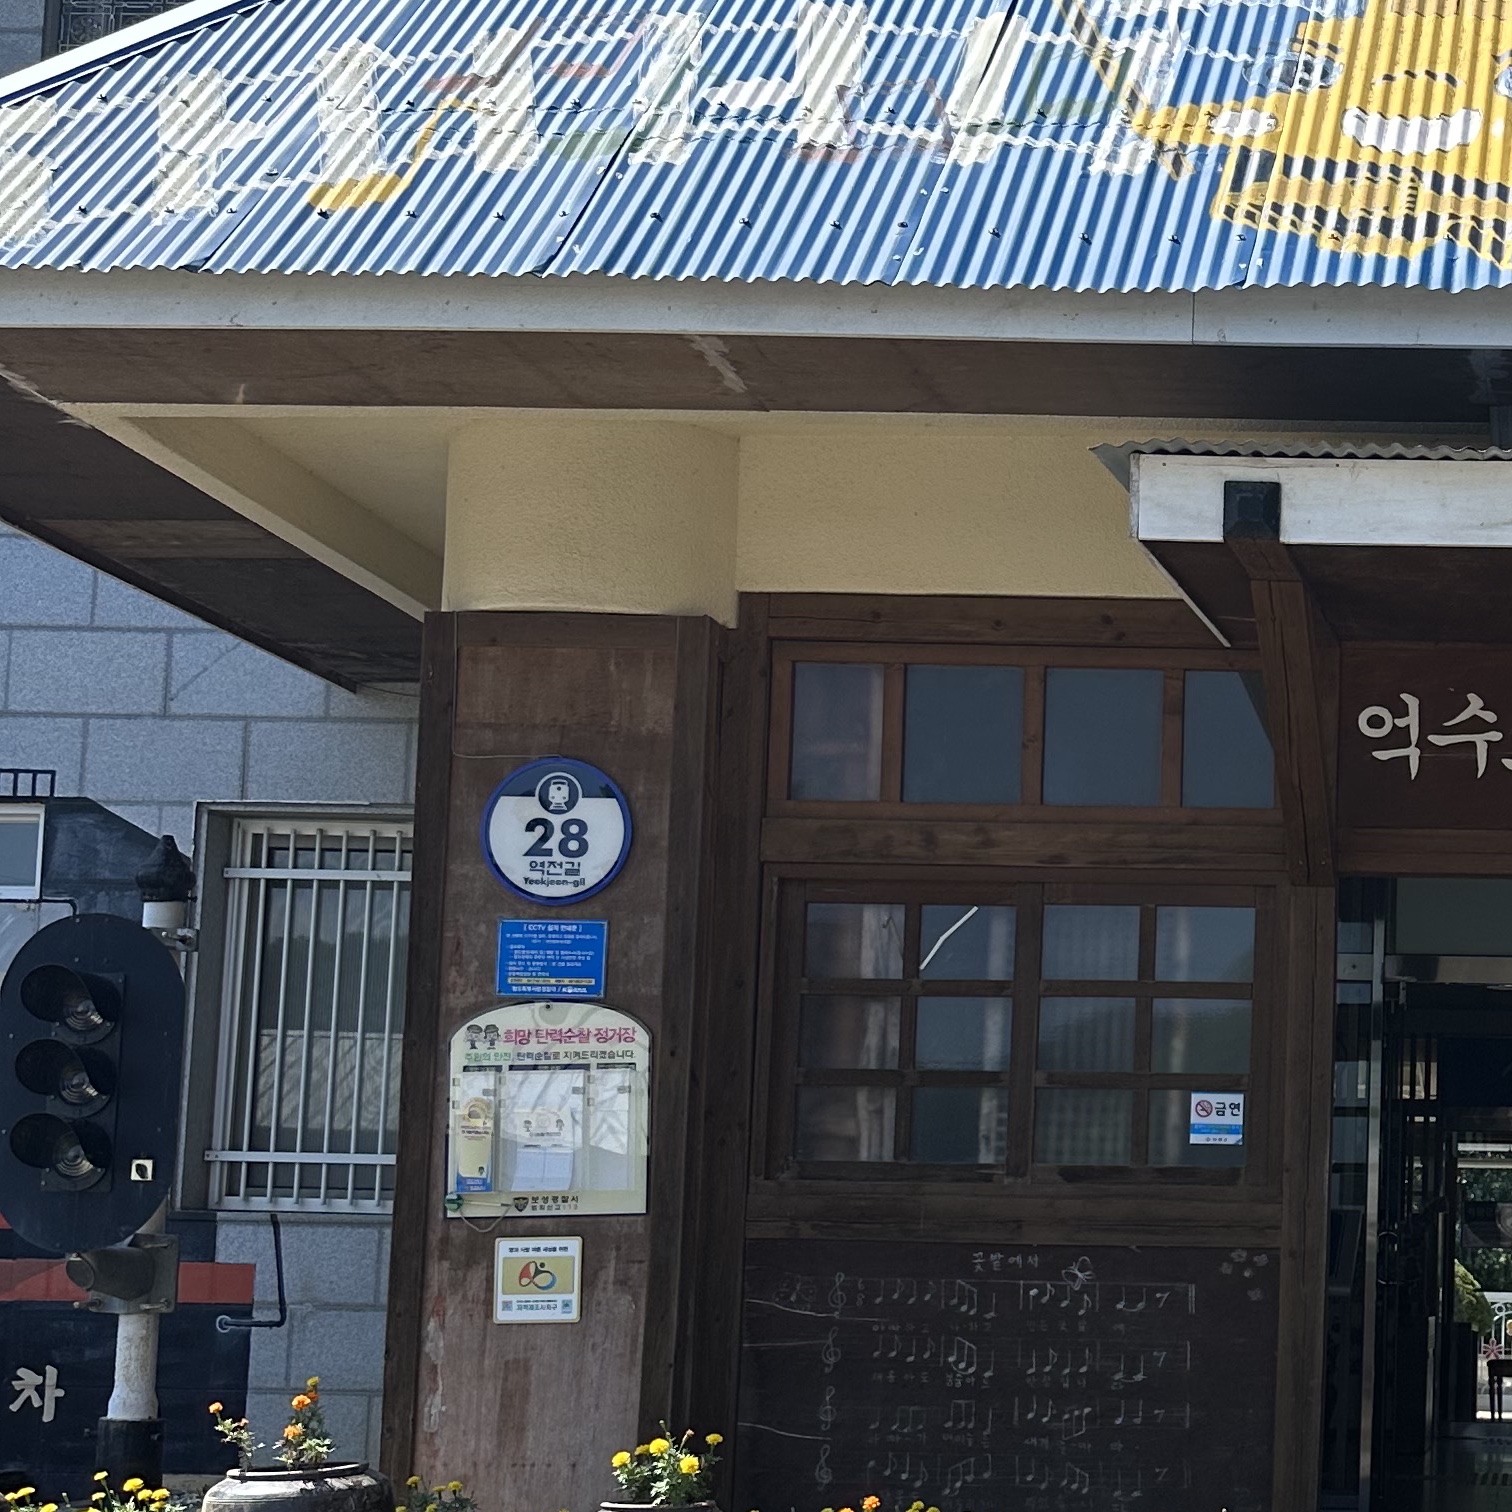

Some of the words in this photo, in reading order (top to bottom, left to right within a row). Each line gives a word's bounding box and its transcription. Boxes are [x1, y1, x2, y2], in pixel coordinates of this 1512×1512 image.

[522, 817, 589, 858] 28
[529, 861, 581, 876] 역전길
[523, 877, 586, 887] Yeokjeon-gil
[503, 1028, 531, 1046] 희망
[535, 1028, 590, 1045] 탄력순찰
[594, 1026, 637, 1043] 정거장
[516, 1051, 561, 1061] 탄력순찰로
[1215, 1102, 1241, 1117] 금연
[531, 1196, 579, 1204] 보성경찰서
[971, 1250, 1040, 1273] 꽃밭에서
[8, 1364, 65, 1423] 차
